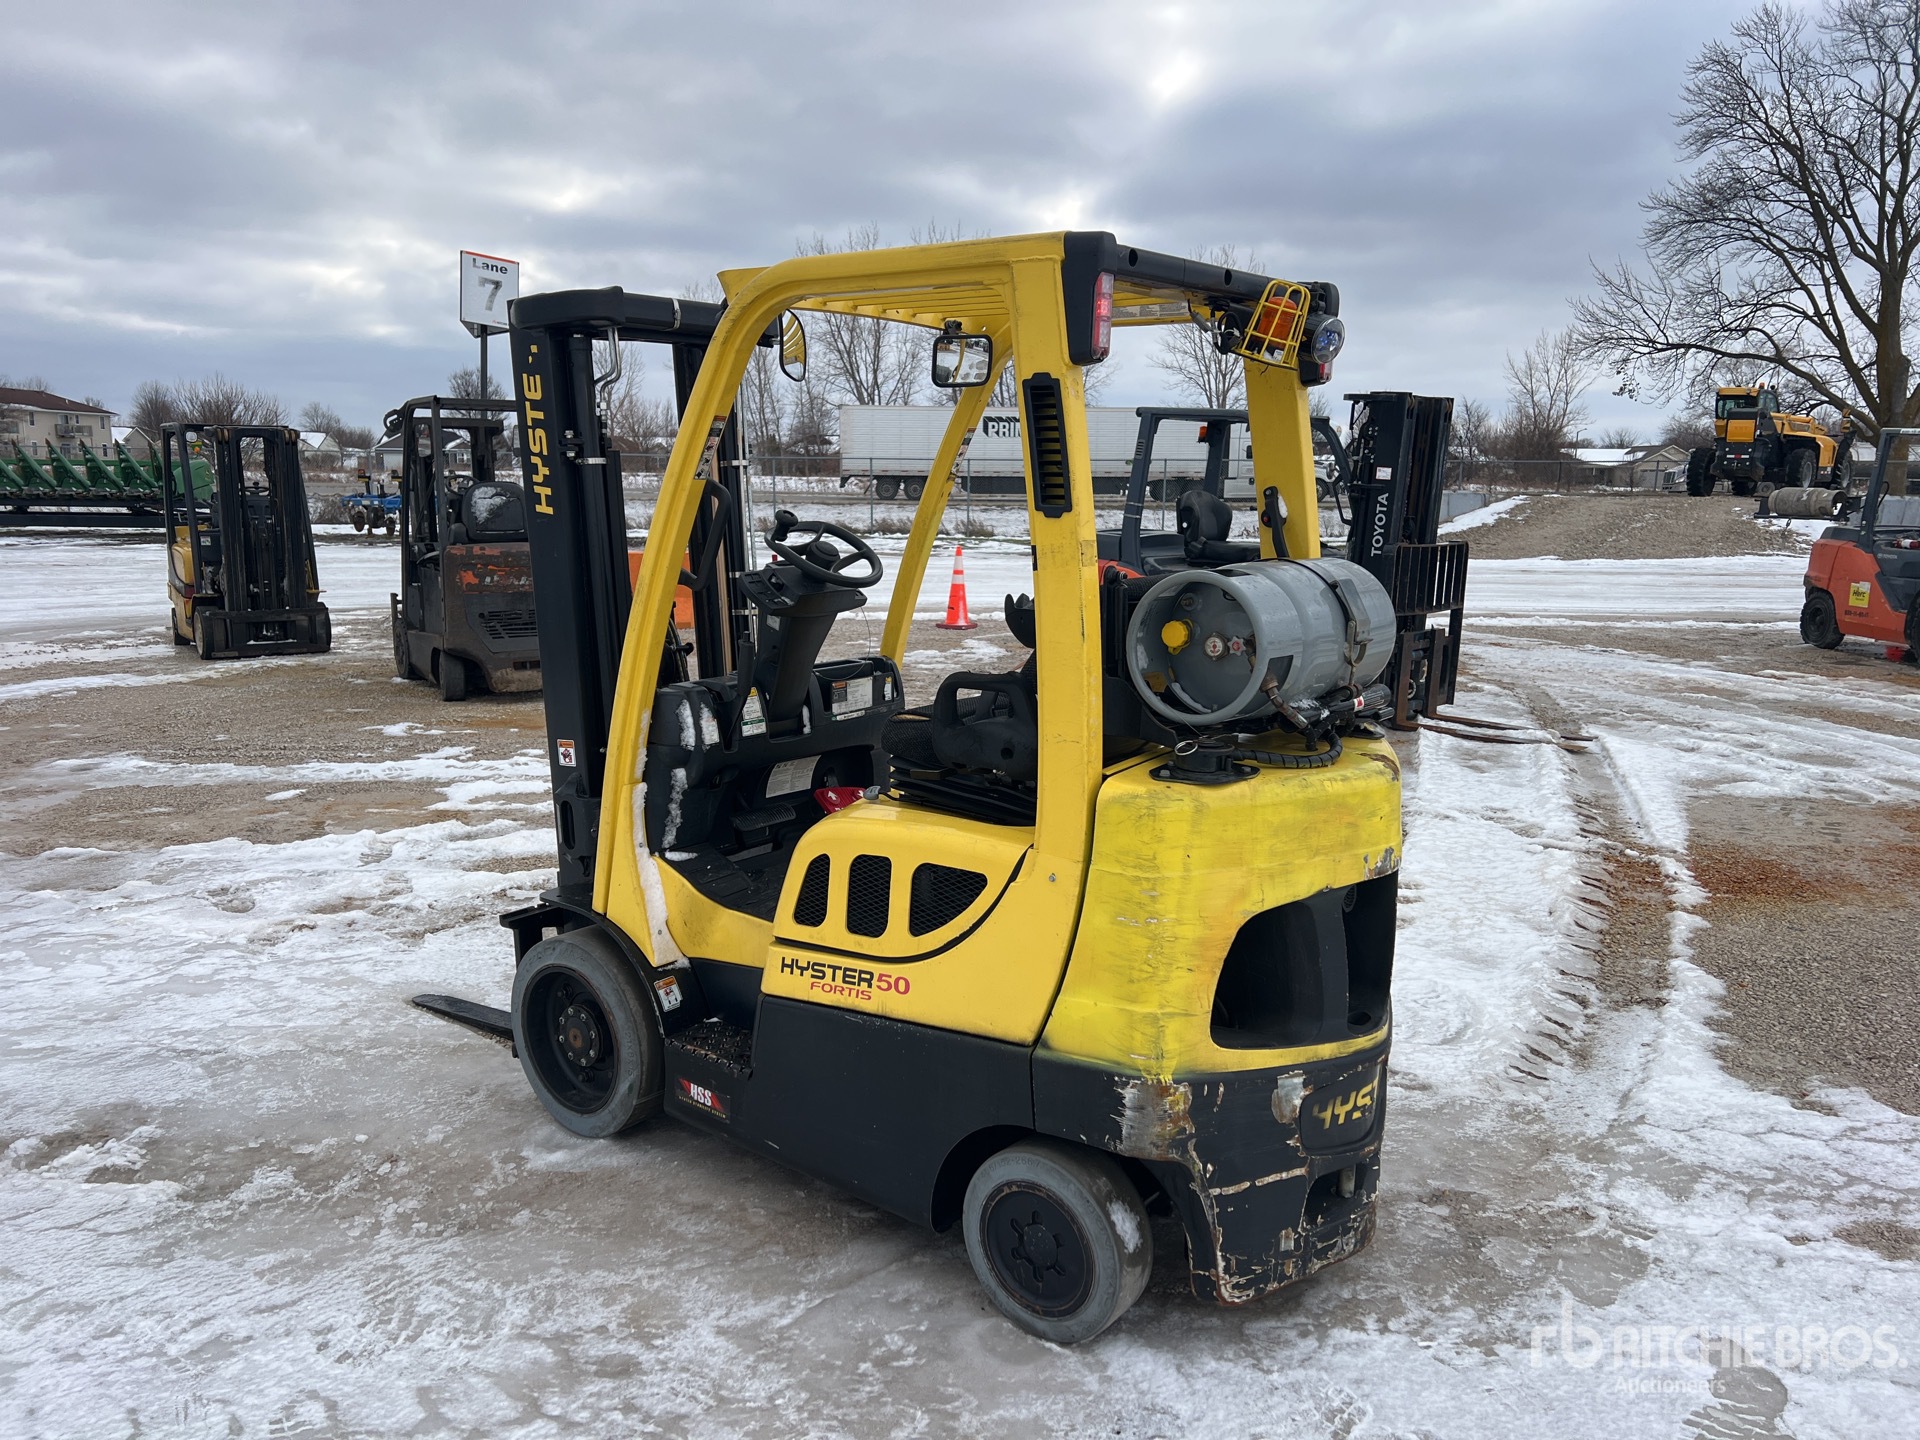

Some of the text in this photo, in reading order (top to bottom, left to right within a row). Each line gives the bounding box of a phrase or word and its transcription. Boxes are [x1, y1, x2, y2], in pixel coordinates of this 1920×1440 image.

[472, 257, 508, 275] Lane
[478, 276, 503, 312] 7
[522, 344, 554, 515] HYSTE
[1371, 493, 1389, 557] TOYOTA
[781, 956, 911, 996] HYSTER 50
[810, 981, 872, 1001] FORTIS
[690, 1083, 712, 1107] HSS
